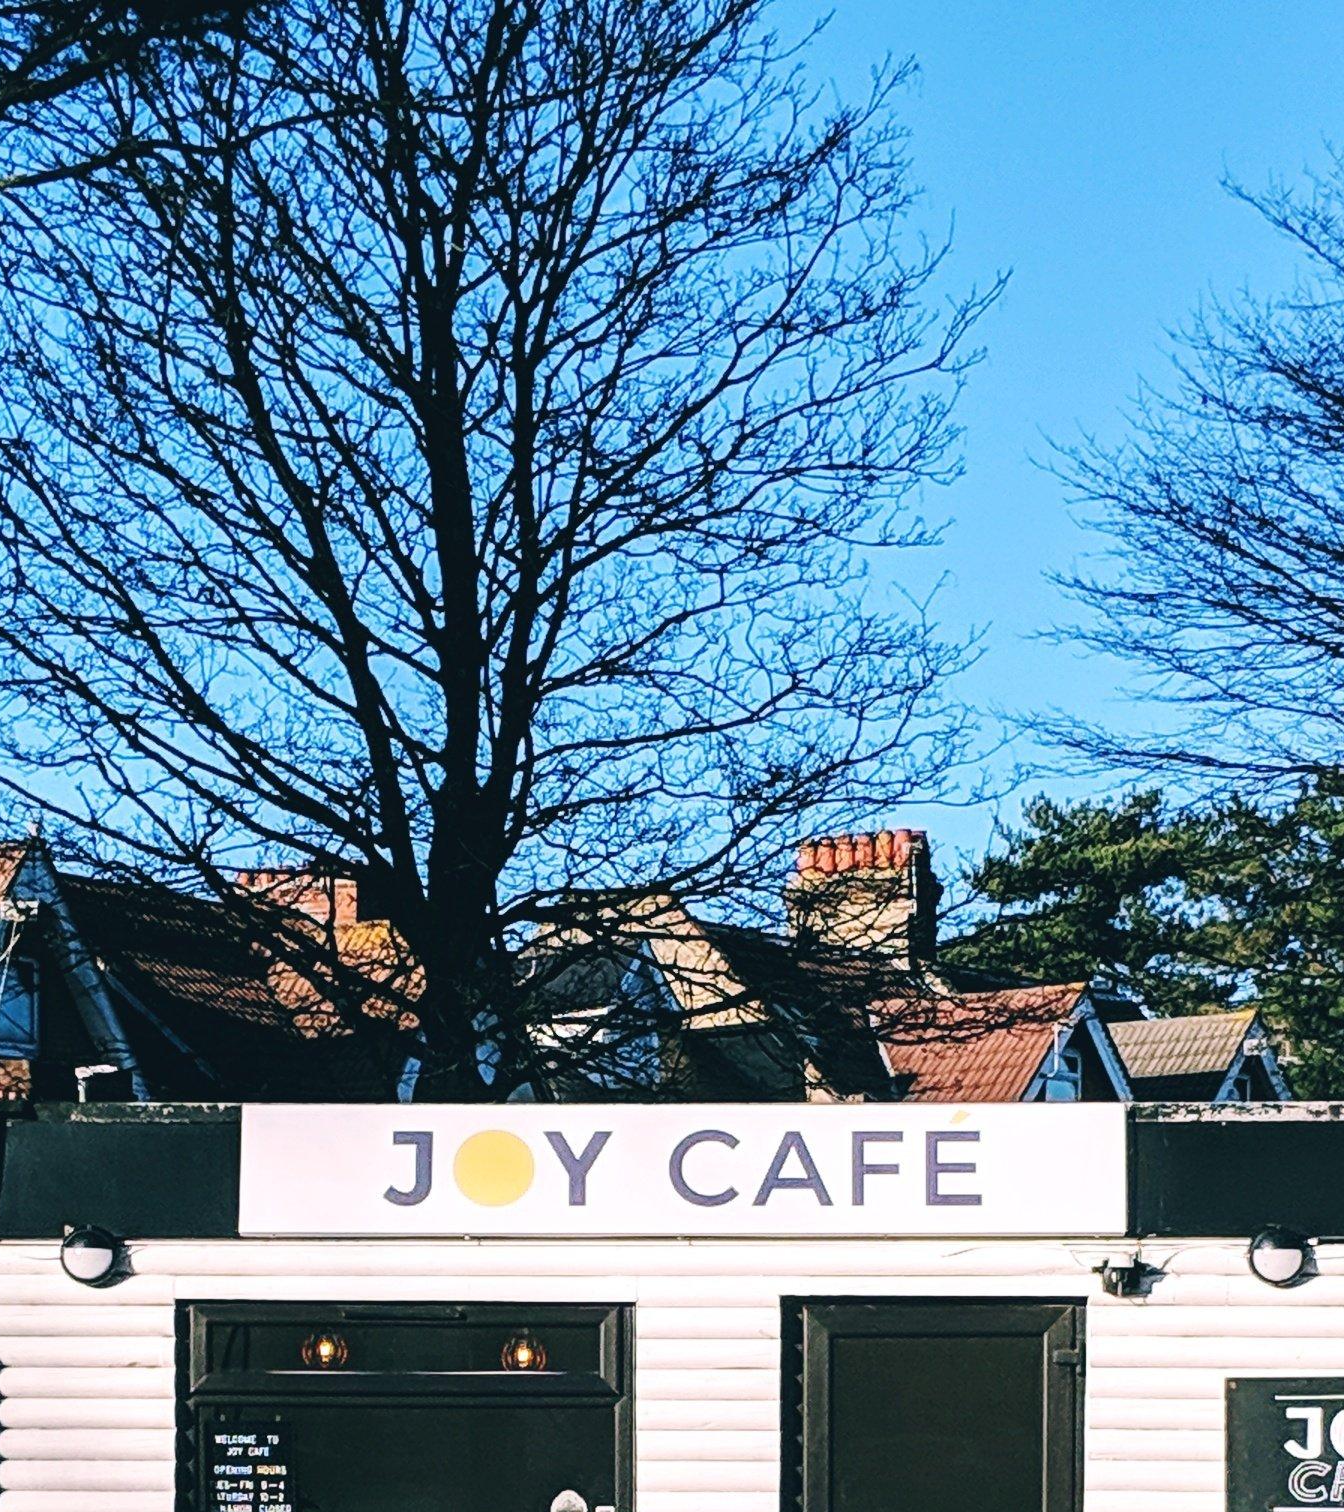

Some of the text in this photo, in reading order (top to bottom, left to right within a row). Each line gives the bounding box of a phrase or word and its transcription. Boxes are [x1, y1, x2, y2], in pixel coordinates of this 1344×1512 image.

[382, 1109, 984, 1208] JOY CAFÉ
[266, 1434, 280, 1445] TO
[226, 1446, 270, 1457] JOY CAFE
[213, 1464, 287, 1476] OPENING HOURS
